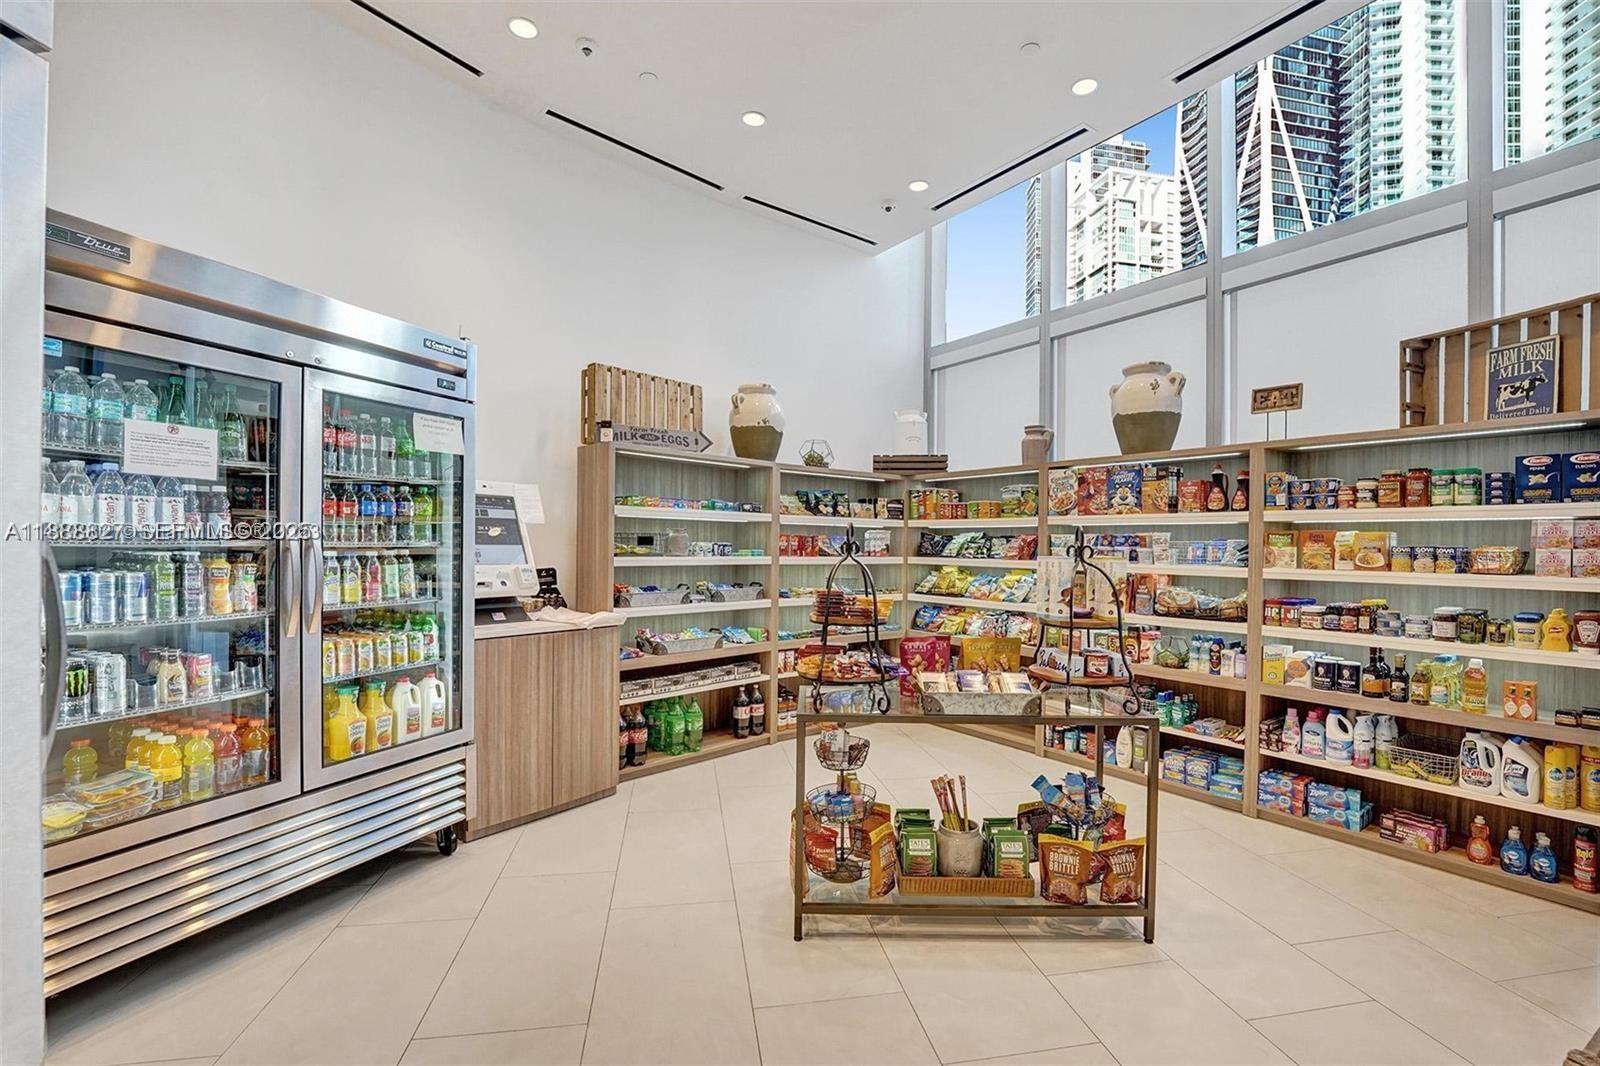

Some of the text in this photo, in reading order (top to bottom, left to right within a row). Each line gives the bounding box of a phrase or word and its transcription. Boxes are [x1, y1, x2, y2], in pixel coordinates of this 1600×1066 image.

[1490, 340, 1554, 373] FARM FRESH
[1498, 361, 1545, 380] MILK
[1490, 406, 1551, 420] Delivered Daily
[661, 434, 690, 448] EGGS
[1049, 851, 1080, 865] BROWNIE
[1108, 851, 1136, 864] BROWNIE
[1049, 861, 1080, 876] BRITTLE
